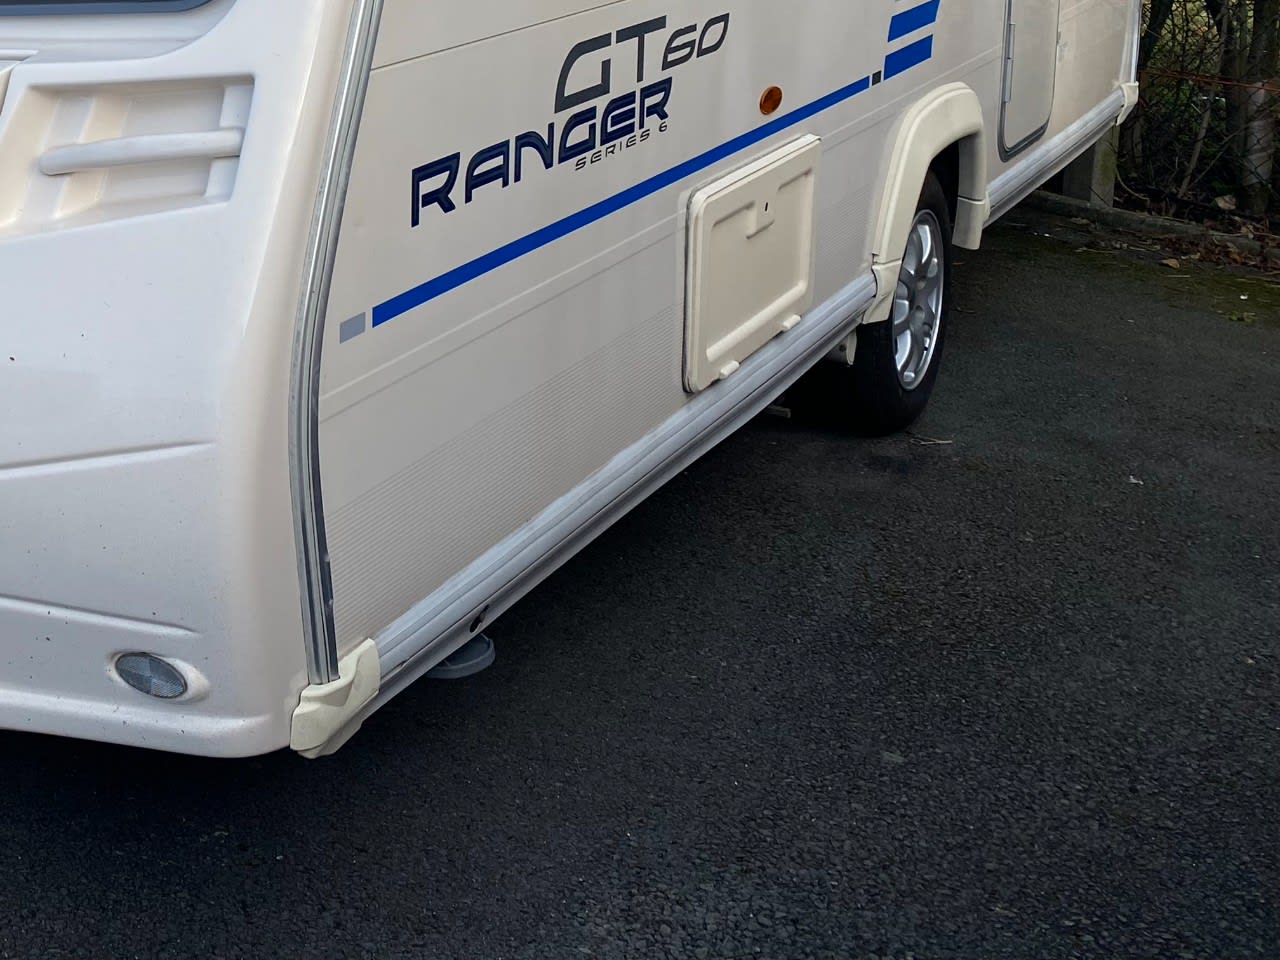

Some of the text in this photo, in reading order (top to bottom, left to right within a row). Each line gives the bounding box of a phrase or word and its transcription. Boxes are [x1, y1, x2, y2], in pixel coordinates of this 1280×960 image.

[411, 76, 673, 228] RANGER
[574, 121, 668, 172] SERIES 6
